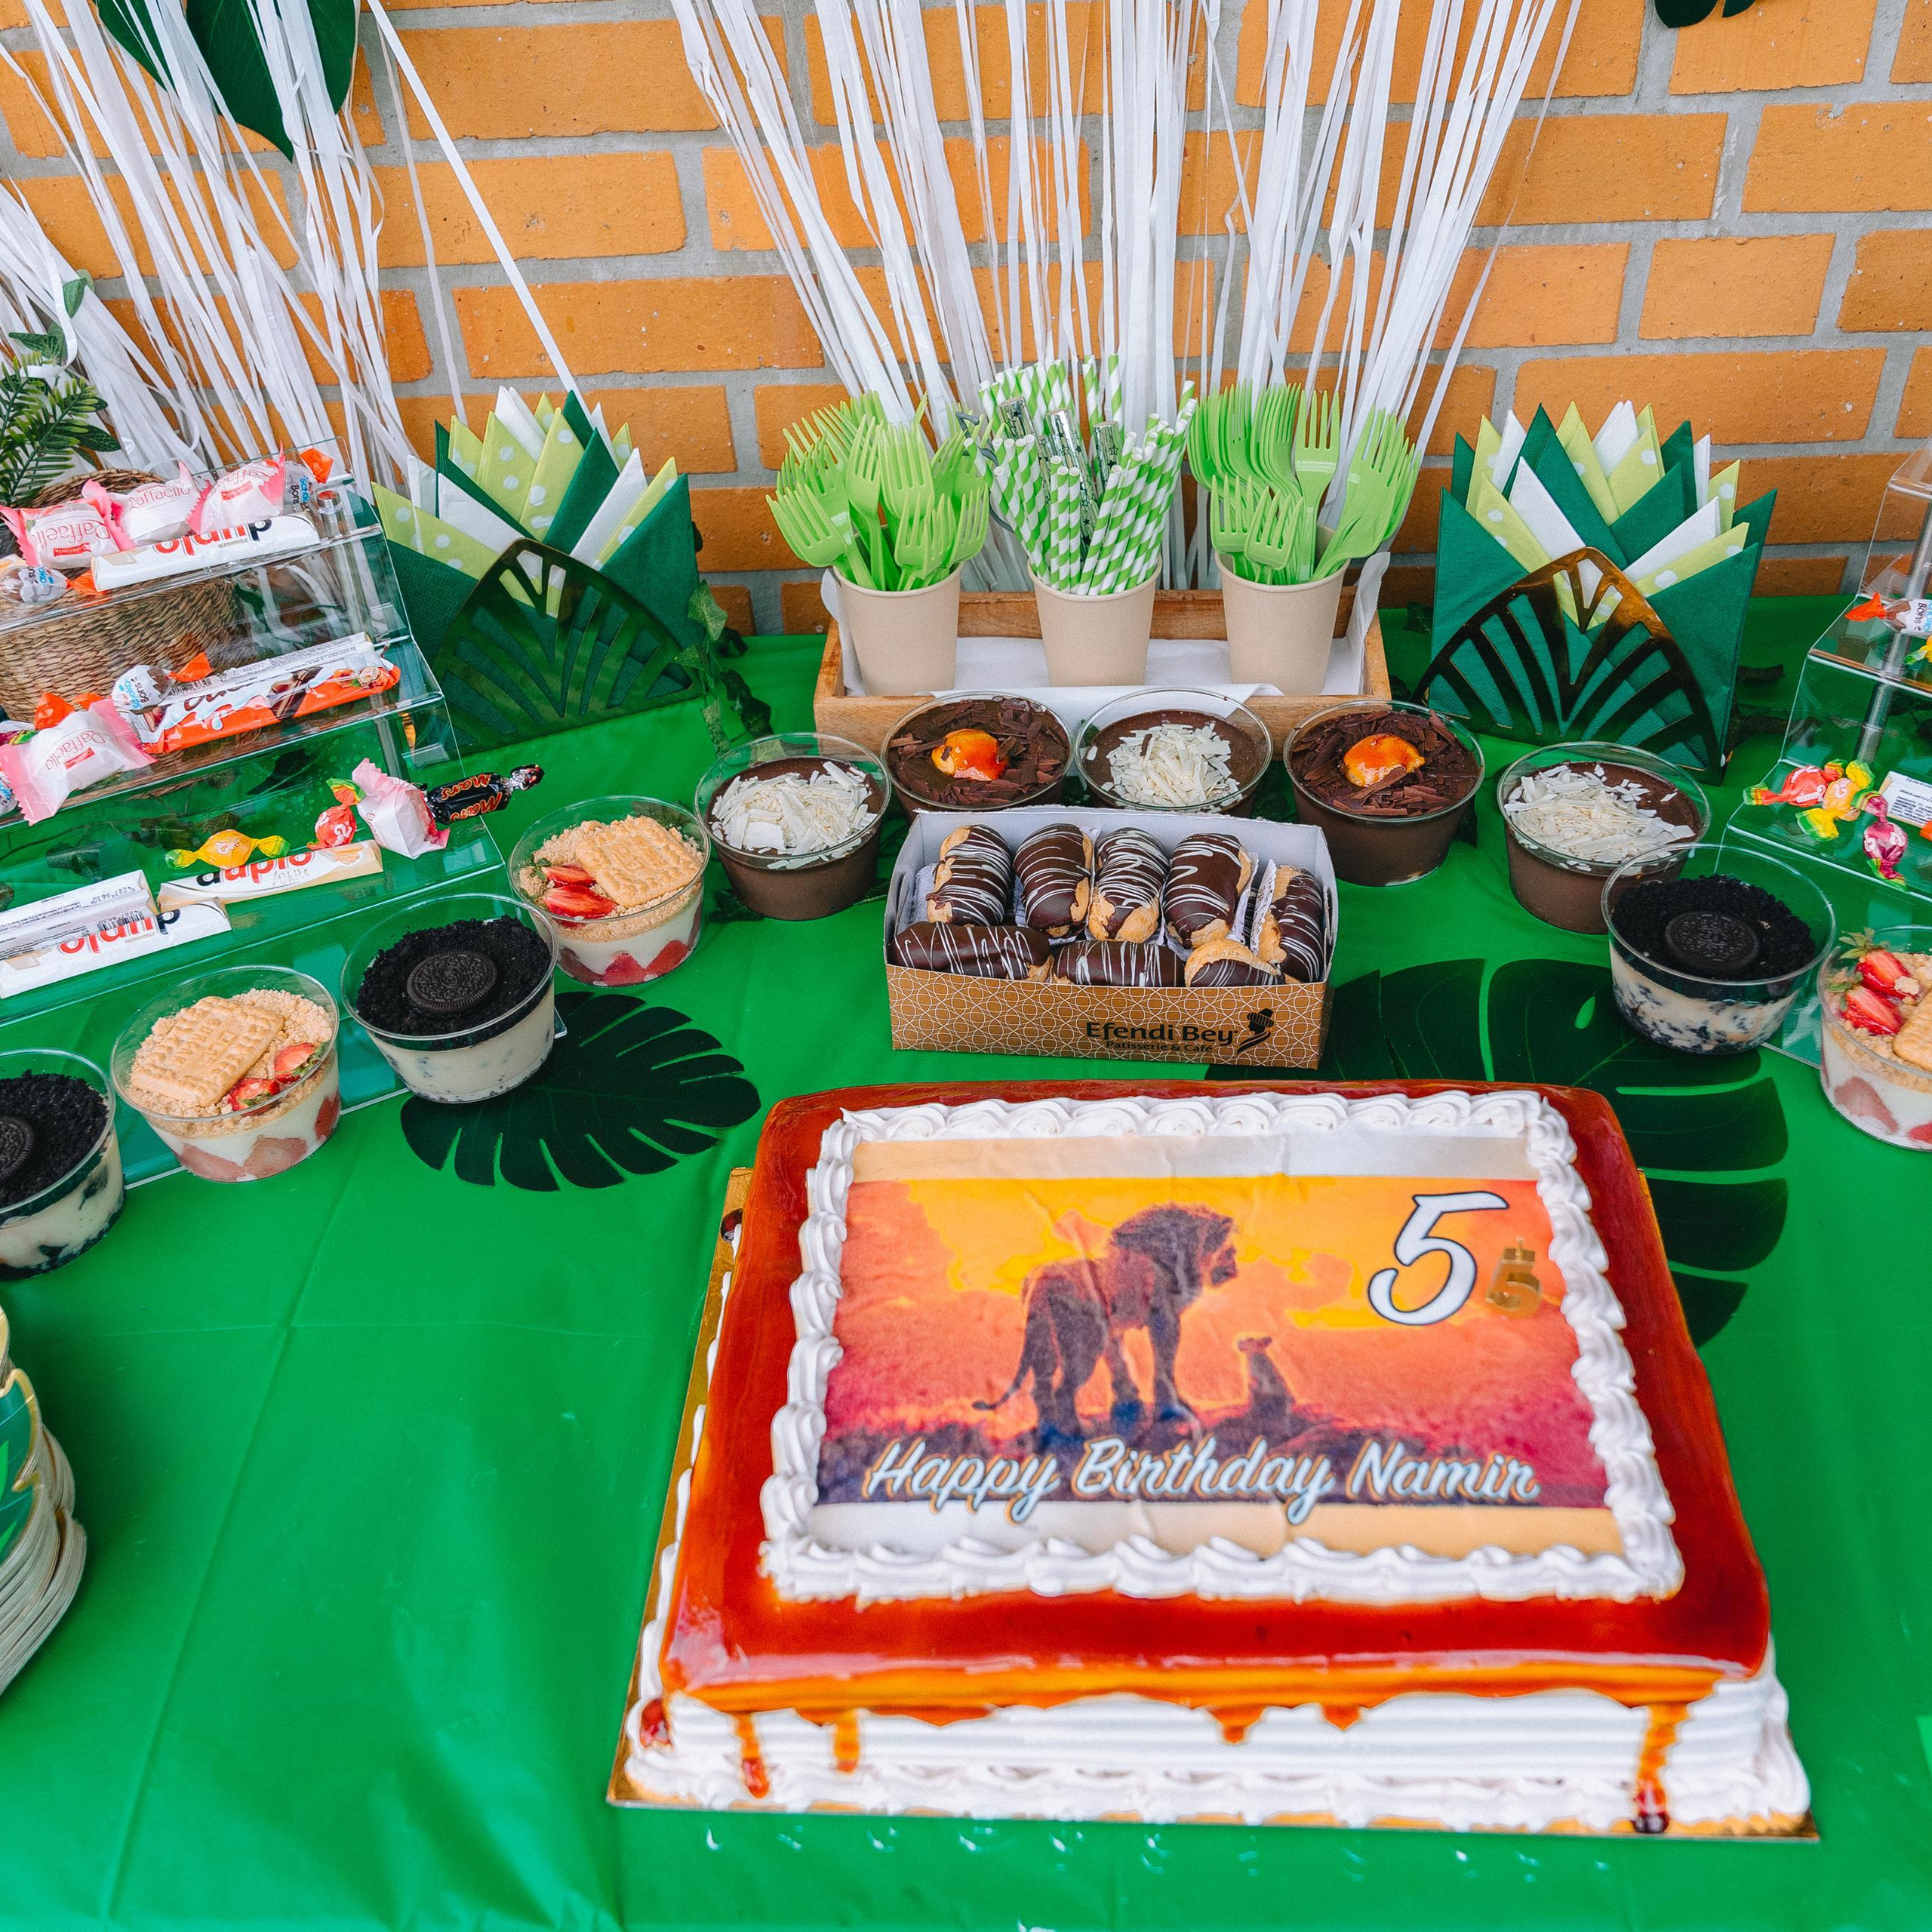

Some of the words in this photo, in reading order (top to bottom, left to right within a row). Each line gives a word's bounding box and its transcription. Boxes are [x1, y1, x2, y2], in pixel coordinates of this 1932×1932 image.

[128, 487, 190, 509] Raffaello
[291, 485, 300, 504] Bons
[1914, 602, 1927, 624] Bons
[134, 681, 149, 703] Bons
[45, 730, 106, 770] Raffaello
[441, 773, 491, 801] Mars
[449, 792, 503, 821] Mars
[59, 908, 180, 954] duplo
[1086, 1021, 1173, 1041] Efendi
[1182, 1025, 1235, 1047] Bey
[1106, 1040, 1168, 1051] Patisserie
[1171, 1043, 1180, 1052] &
[1183, 1043, 1214, 1053] Café
[1367, 1190, 1510, 1326] 5
[863, 1438, 1061, 1524] Happy
[1072, 1436, 1336, 1524] Birthday
[1347, 1438, 1541, 1501] Namir
